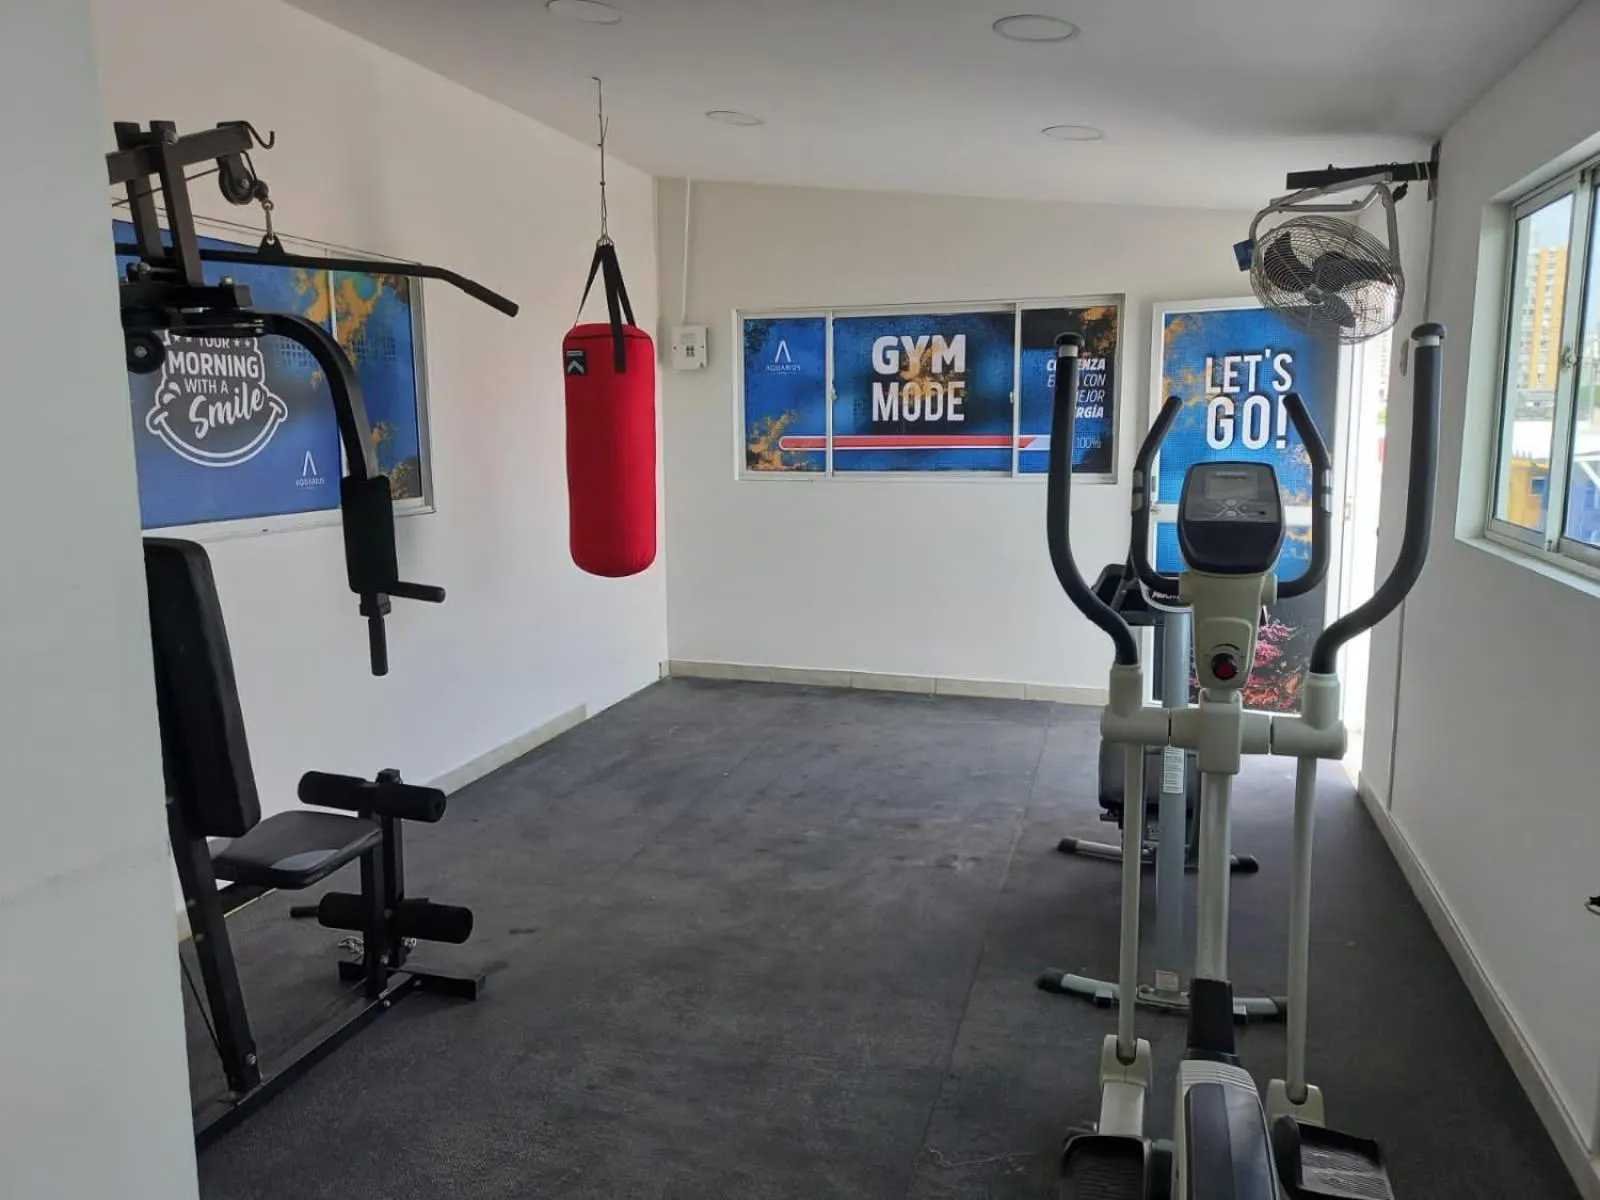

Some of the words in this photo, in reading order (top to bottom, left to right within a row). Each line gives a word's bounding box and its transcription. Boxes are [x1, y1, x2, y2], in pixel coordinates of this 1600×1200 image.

[168, 350, 259, 378] MORNING
[871, 334, 966, 375] GYM
[1205, 349, 1293, 393] LET'S
[184, 378, 217, 393] WITH
[220, 380, 229, 394] A
[1083, 373, 1107, 386] CON
[189, 382, 264, 439] Smile
[872, 381, 965, 422] MODE
[1206, 394, 1288, 450] GO!
